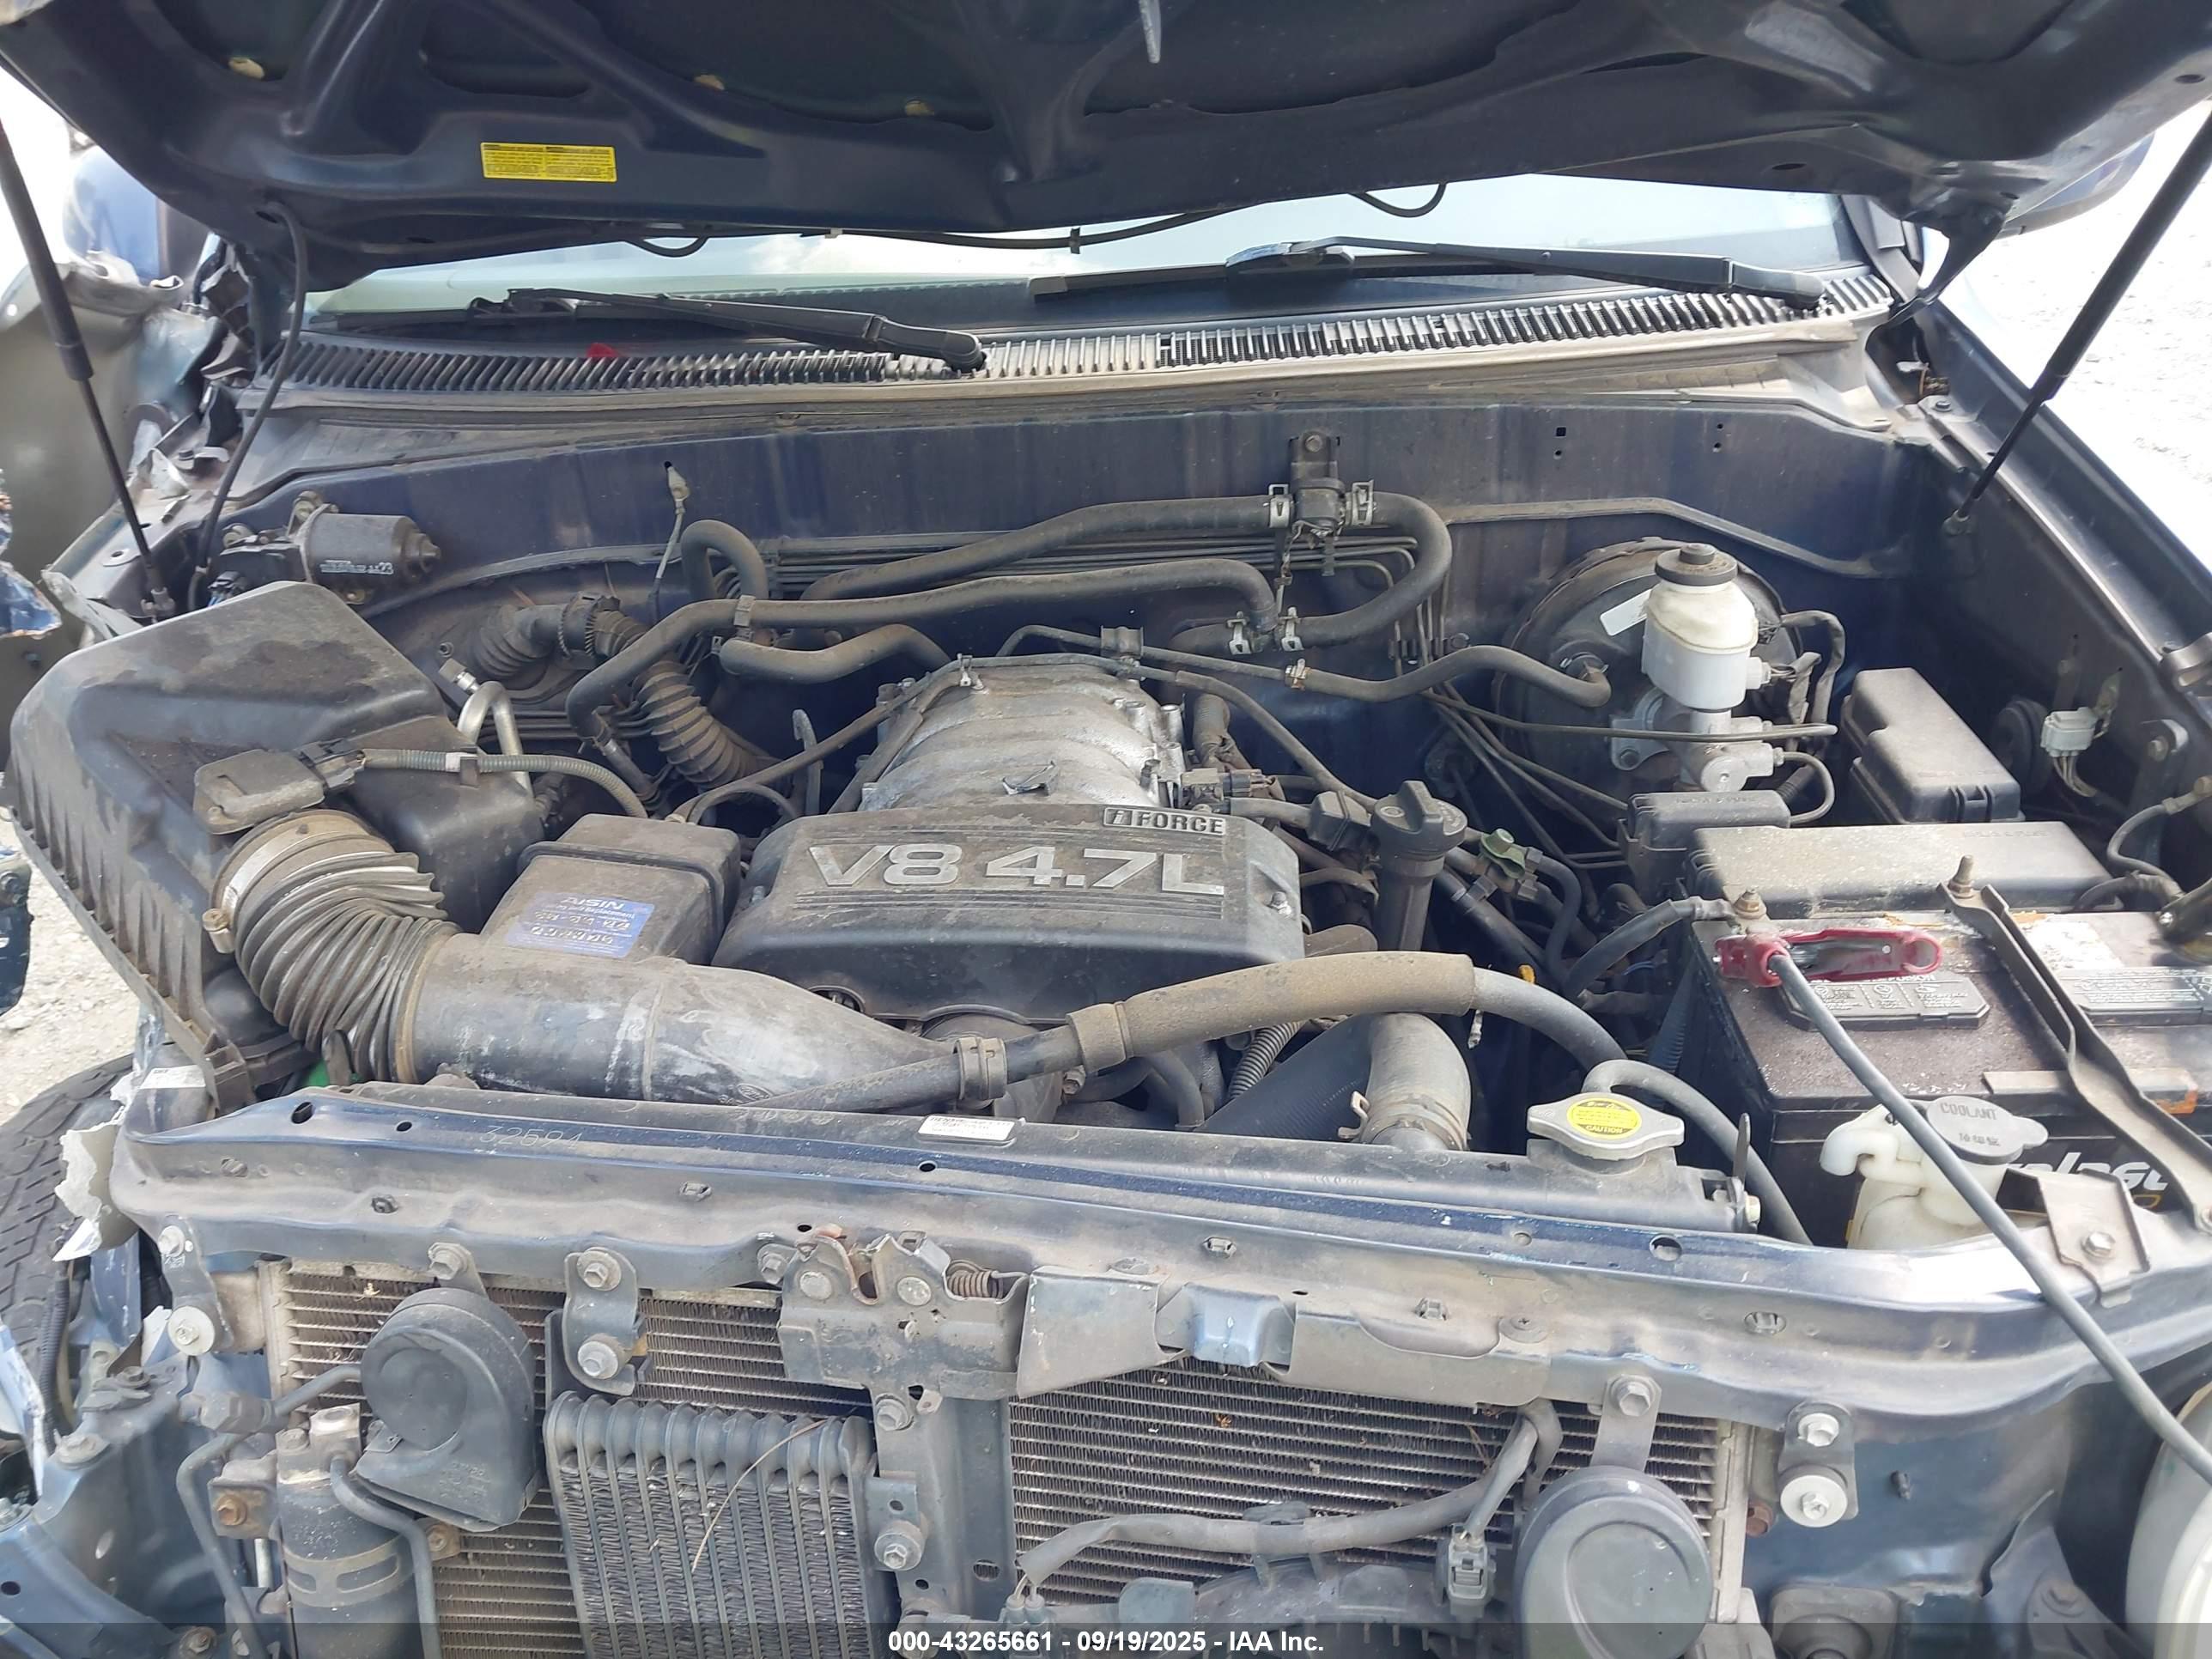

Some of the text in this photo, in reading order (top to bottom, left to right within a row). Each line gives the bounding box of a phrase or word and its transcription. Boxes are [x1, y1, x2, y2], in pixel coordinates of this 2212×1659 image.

[1135, 811, 1224, 835] FORCE
[808, 843, 1224, 896] V8 4.7L
[560, 896, 625, 910] AISIN
[1940, 1102, 1998, 1121] COOLANT
[1585, 1125, 1623, 1133] CAUTION
